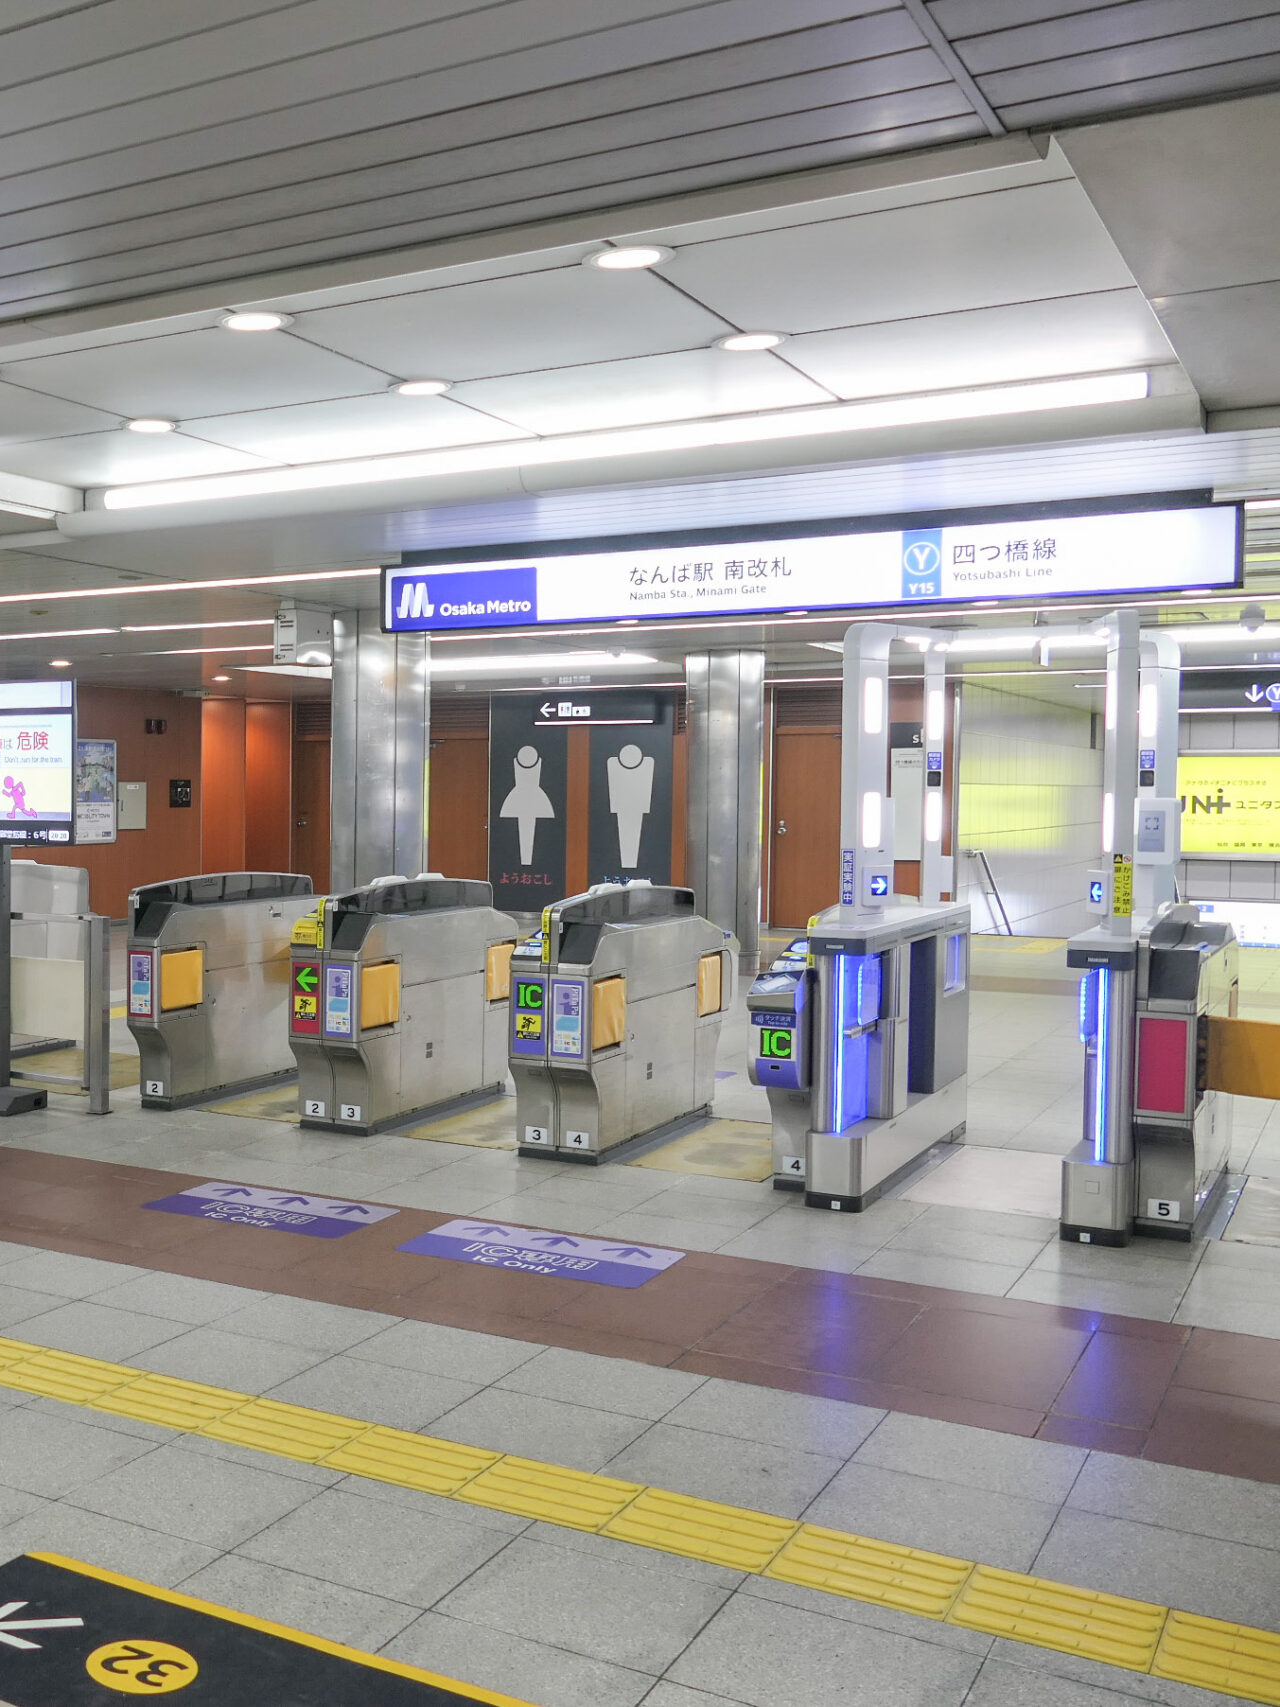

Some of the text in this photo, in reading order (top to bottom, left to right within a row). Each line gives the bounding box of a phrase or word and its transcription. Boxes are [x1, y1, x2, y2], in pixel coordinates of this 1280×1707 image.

[912, 547, 931, 570] Y
[953, 538, 1057, 565] 四つ橋線
[629, 556, 792, 585] なんば駅 南改札
[953, 567, 1053, 581] Yotsubashi Line
[629, 589, 668, 601] Namba
[696, 585, 738, 596] Minami
[741, 583, 767, 595] Gate
[908, 582, 935, 595] Y15
[439, 599, 532, 617] Osaka Metro
[17, 731, 49, 751] 危険
[500, 873, 553, 886] ようおこし
[518, 984, 542, 1007] IC
[762, 1030, 791, 1056] IC
[152, 1083, 158, 1093] 2
[312, 1103, 355, 1118] 2 3
[532, 1130, 582, 1145] 3 4
[791, 1160, 801, 1171] 4
[1158, 1202, 1170, 1216] 5
[230, 1216, 276, 1227] Only
[473, 1255, 557, 1273] IC Only
[101, 1645, 189, 1687] 32
